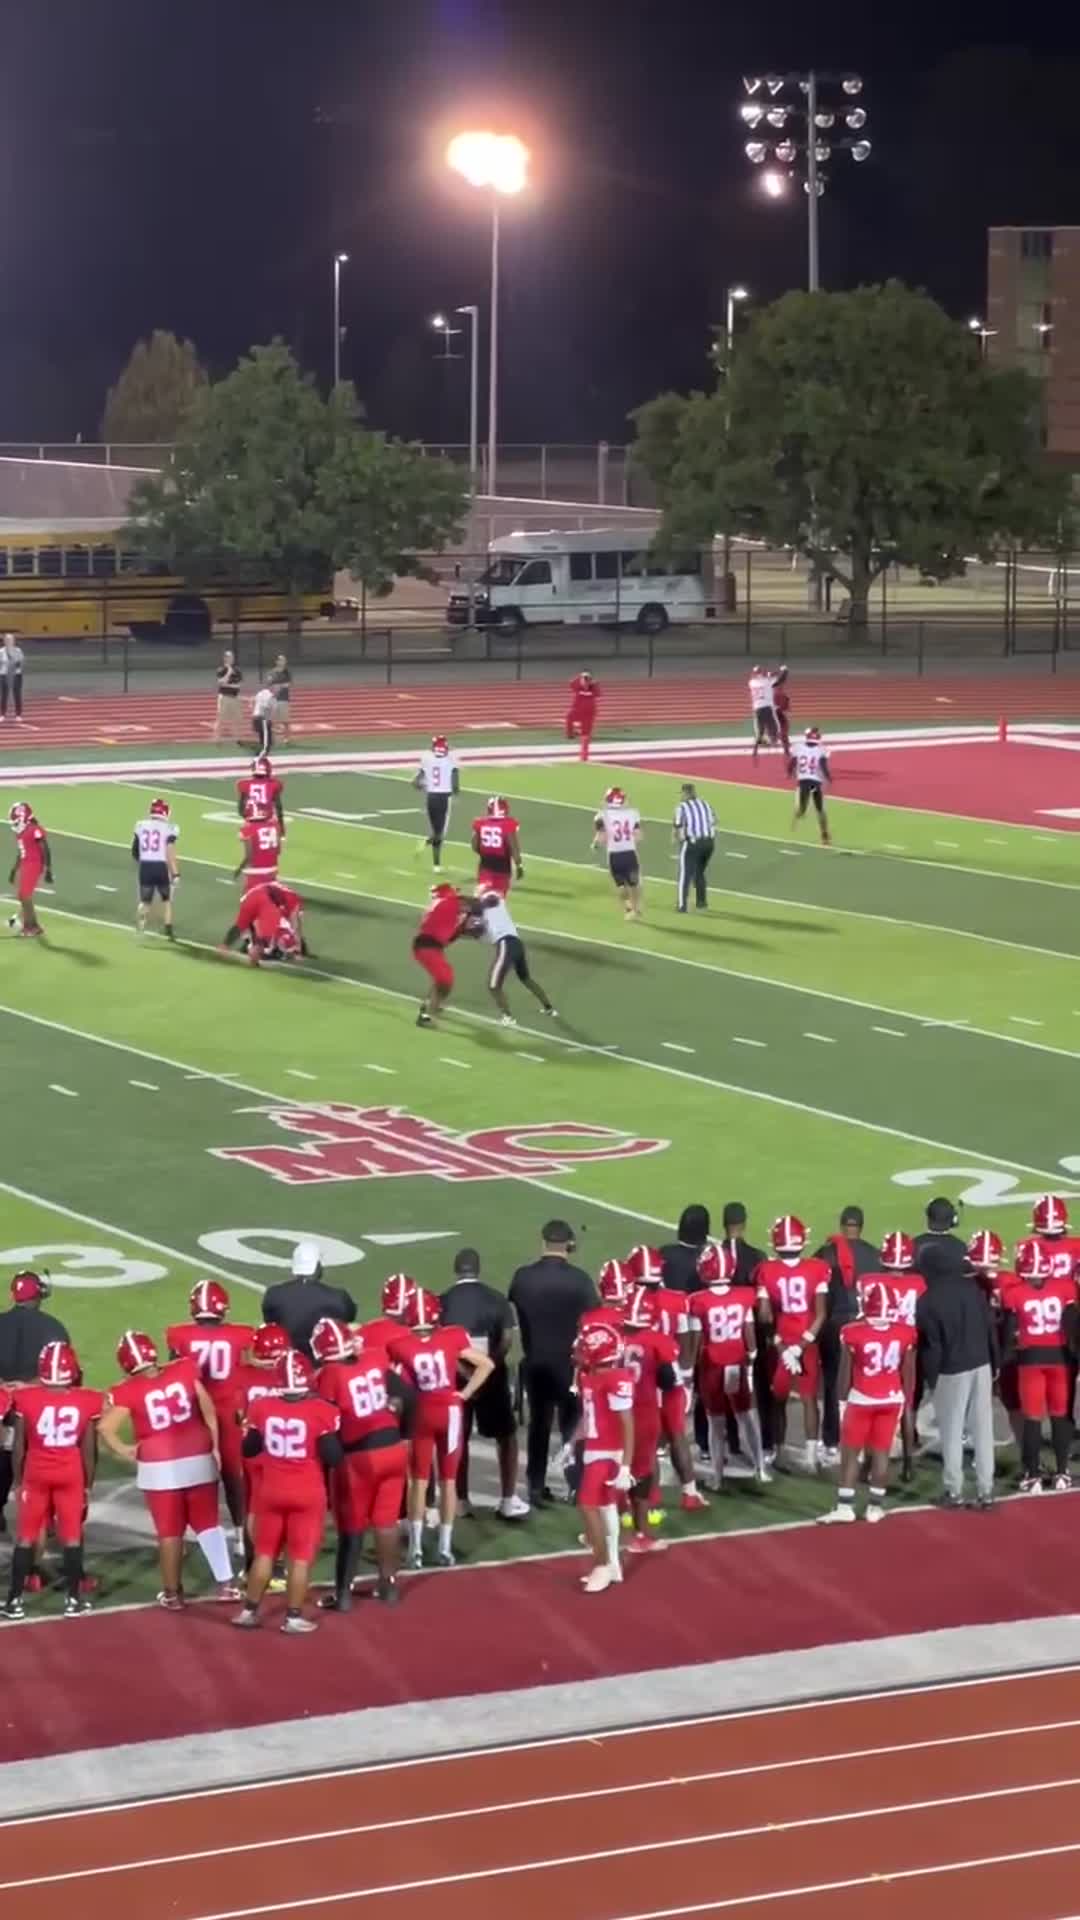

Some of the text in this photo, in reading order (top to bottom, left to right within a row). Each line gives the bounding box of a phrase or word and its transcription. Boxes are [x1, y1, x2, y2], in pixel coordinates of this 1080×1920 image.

[432, 767, 441, 786] 9
[799, 756, 817, 774] 24
[141, 830, 161, 852] 33
[613, 821, 631, 842] 34
[777, 1277, 807, 1313] 19
[708, 1304, 744, 1343] 82
[1024, 1296, 1062, 1335] 39
[190, 1340, 231, 1380] 70
[413, 1351, 450, 1391] 81
[863, 1340, 901, 1377] 34
[144, 1382, 192, 1431] 63
[348, 1368, 388, 1417] 66
[36, 1405, 80, 1448] 42
[265, 1416, 306, 1459] 62
